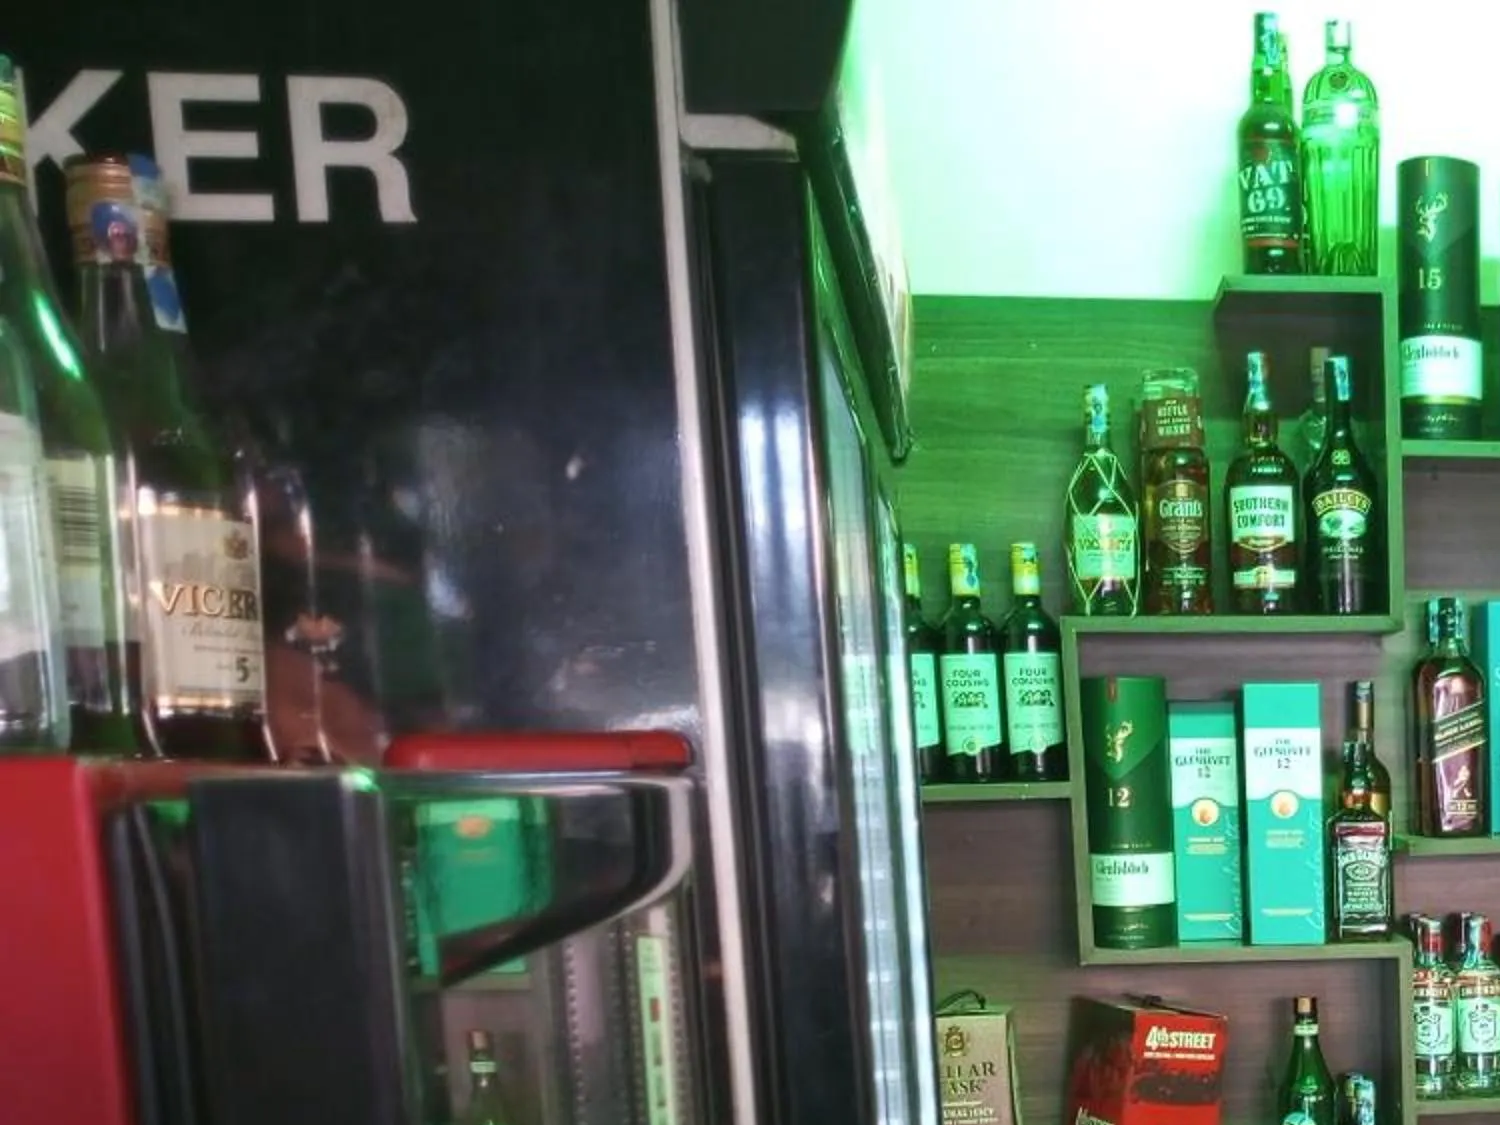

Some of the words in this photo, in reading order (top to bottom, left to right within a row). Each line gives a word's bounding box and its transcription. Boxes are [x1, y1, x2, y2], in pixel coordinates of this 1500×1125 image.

[1239, 160, 1294, 192] VAT
[1419, 268, 1442, 290] 15
[1233, 497, 1289, 512] SOUTHERN
[1237, 514, 1285, 529] COMFORT
[1108, 787, 1131, 809] 12
